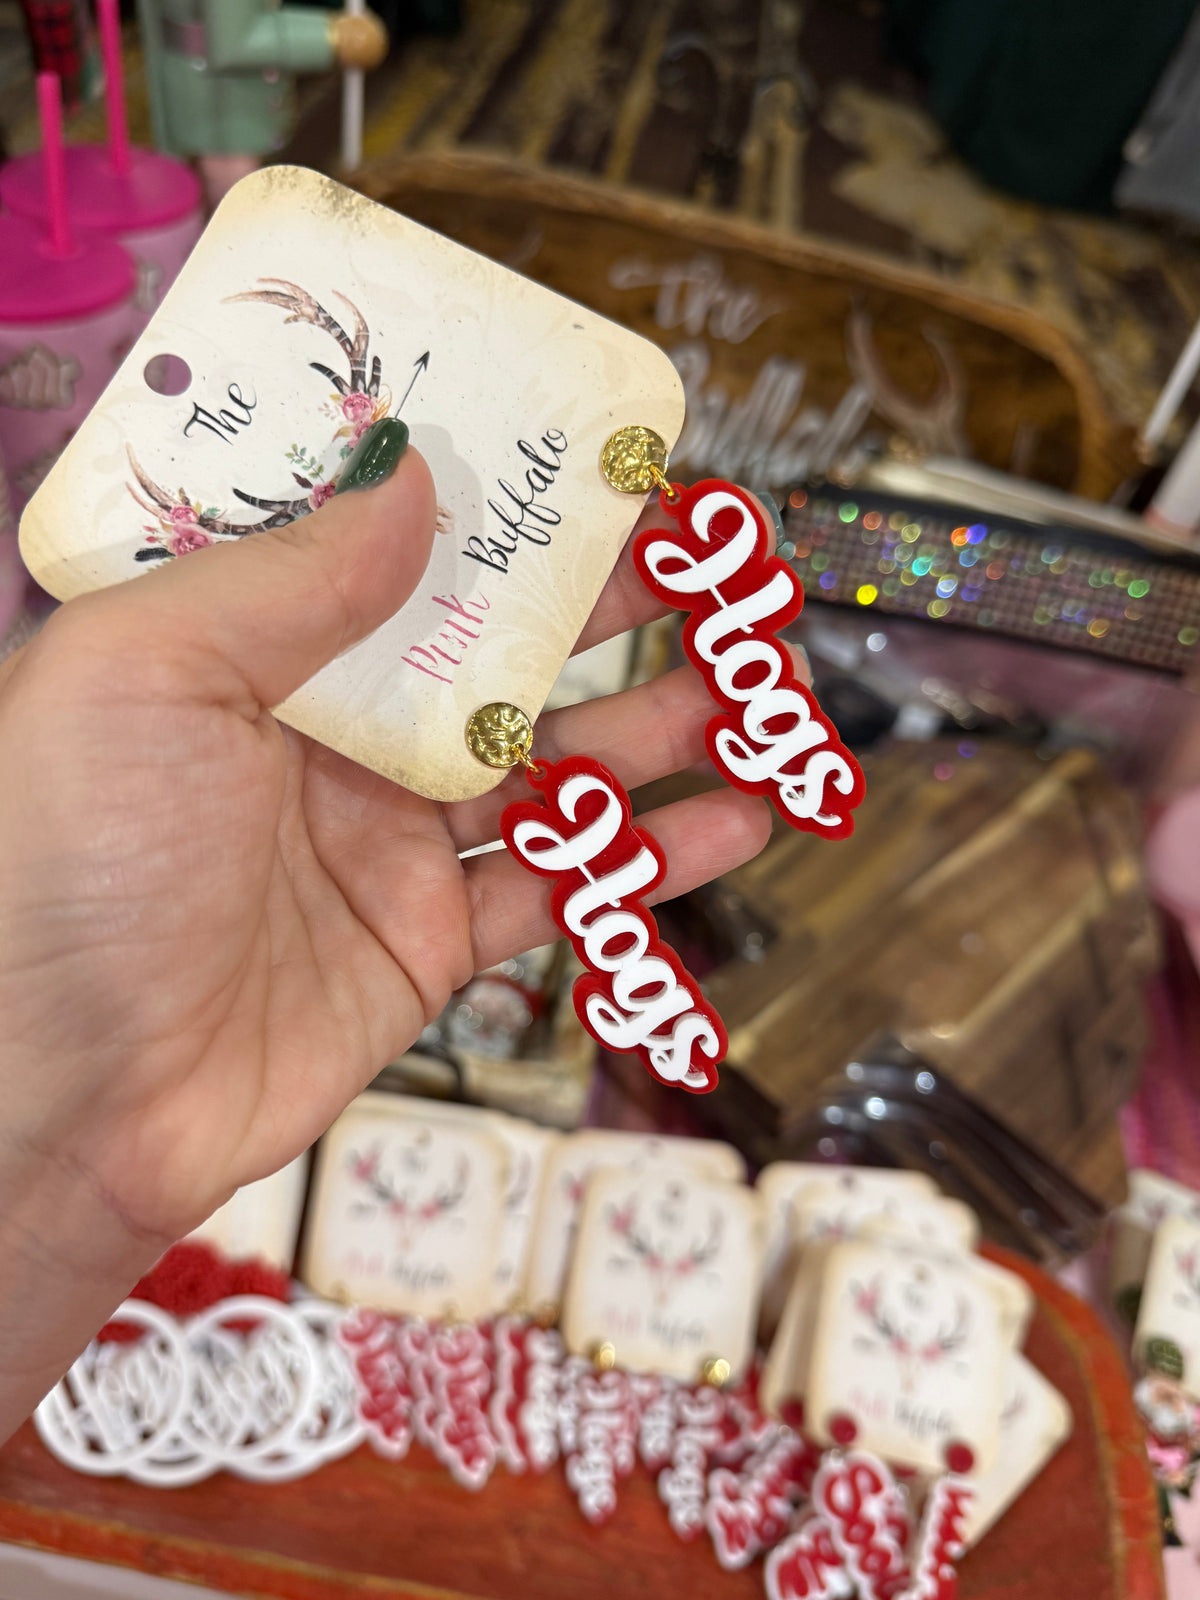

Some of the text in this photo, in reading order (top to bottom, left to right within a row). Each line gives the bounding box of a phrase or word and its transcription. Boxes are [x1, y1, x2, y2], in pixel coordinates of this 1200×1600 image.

[183, 382, 257, 446] The
[400, 428, 568, 685] Pink Buffalo
[643, 490, 855, 827] Hogs
[512, 773, 720, 1089] Hogs
